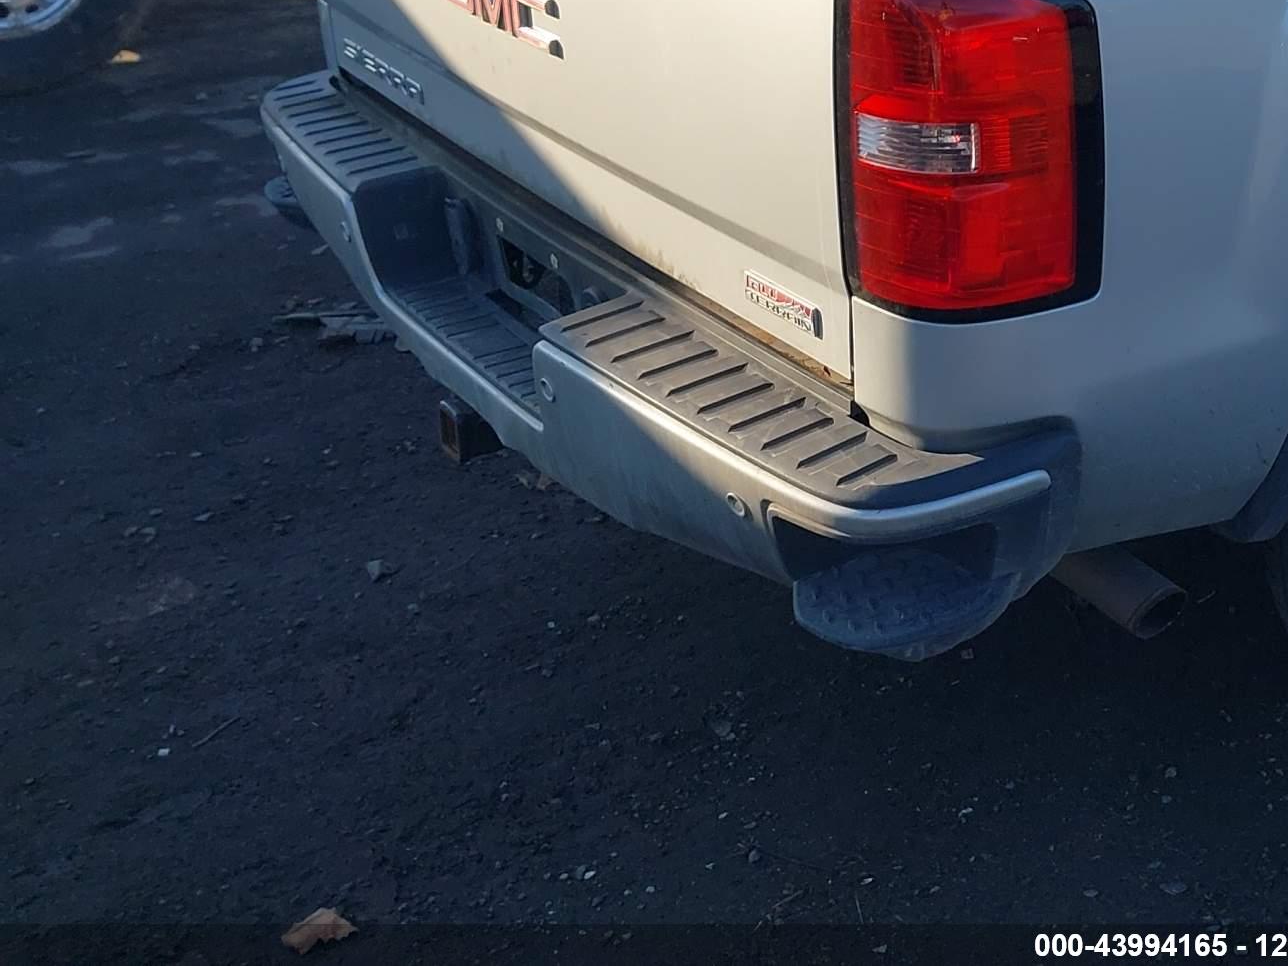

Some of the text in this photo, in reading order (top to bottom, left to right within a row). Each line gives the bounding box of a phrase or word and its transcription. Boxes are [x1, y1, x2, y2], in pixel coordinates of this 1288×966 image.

[343, 37, 425, 105] SIERRA
[746, 275, 778, 300] ALL
[745, 289, 813, 332] TERRAIN
